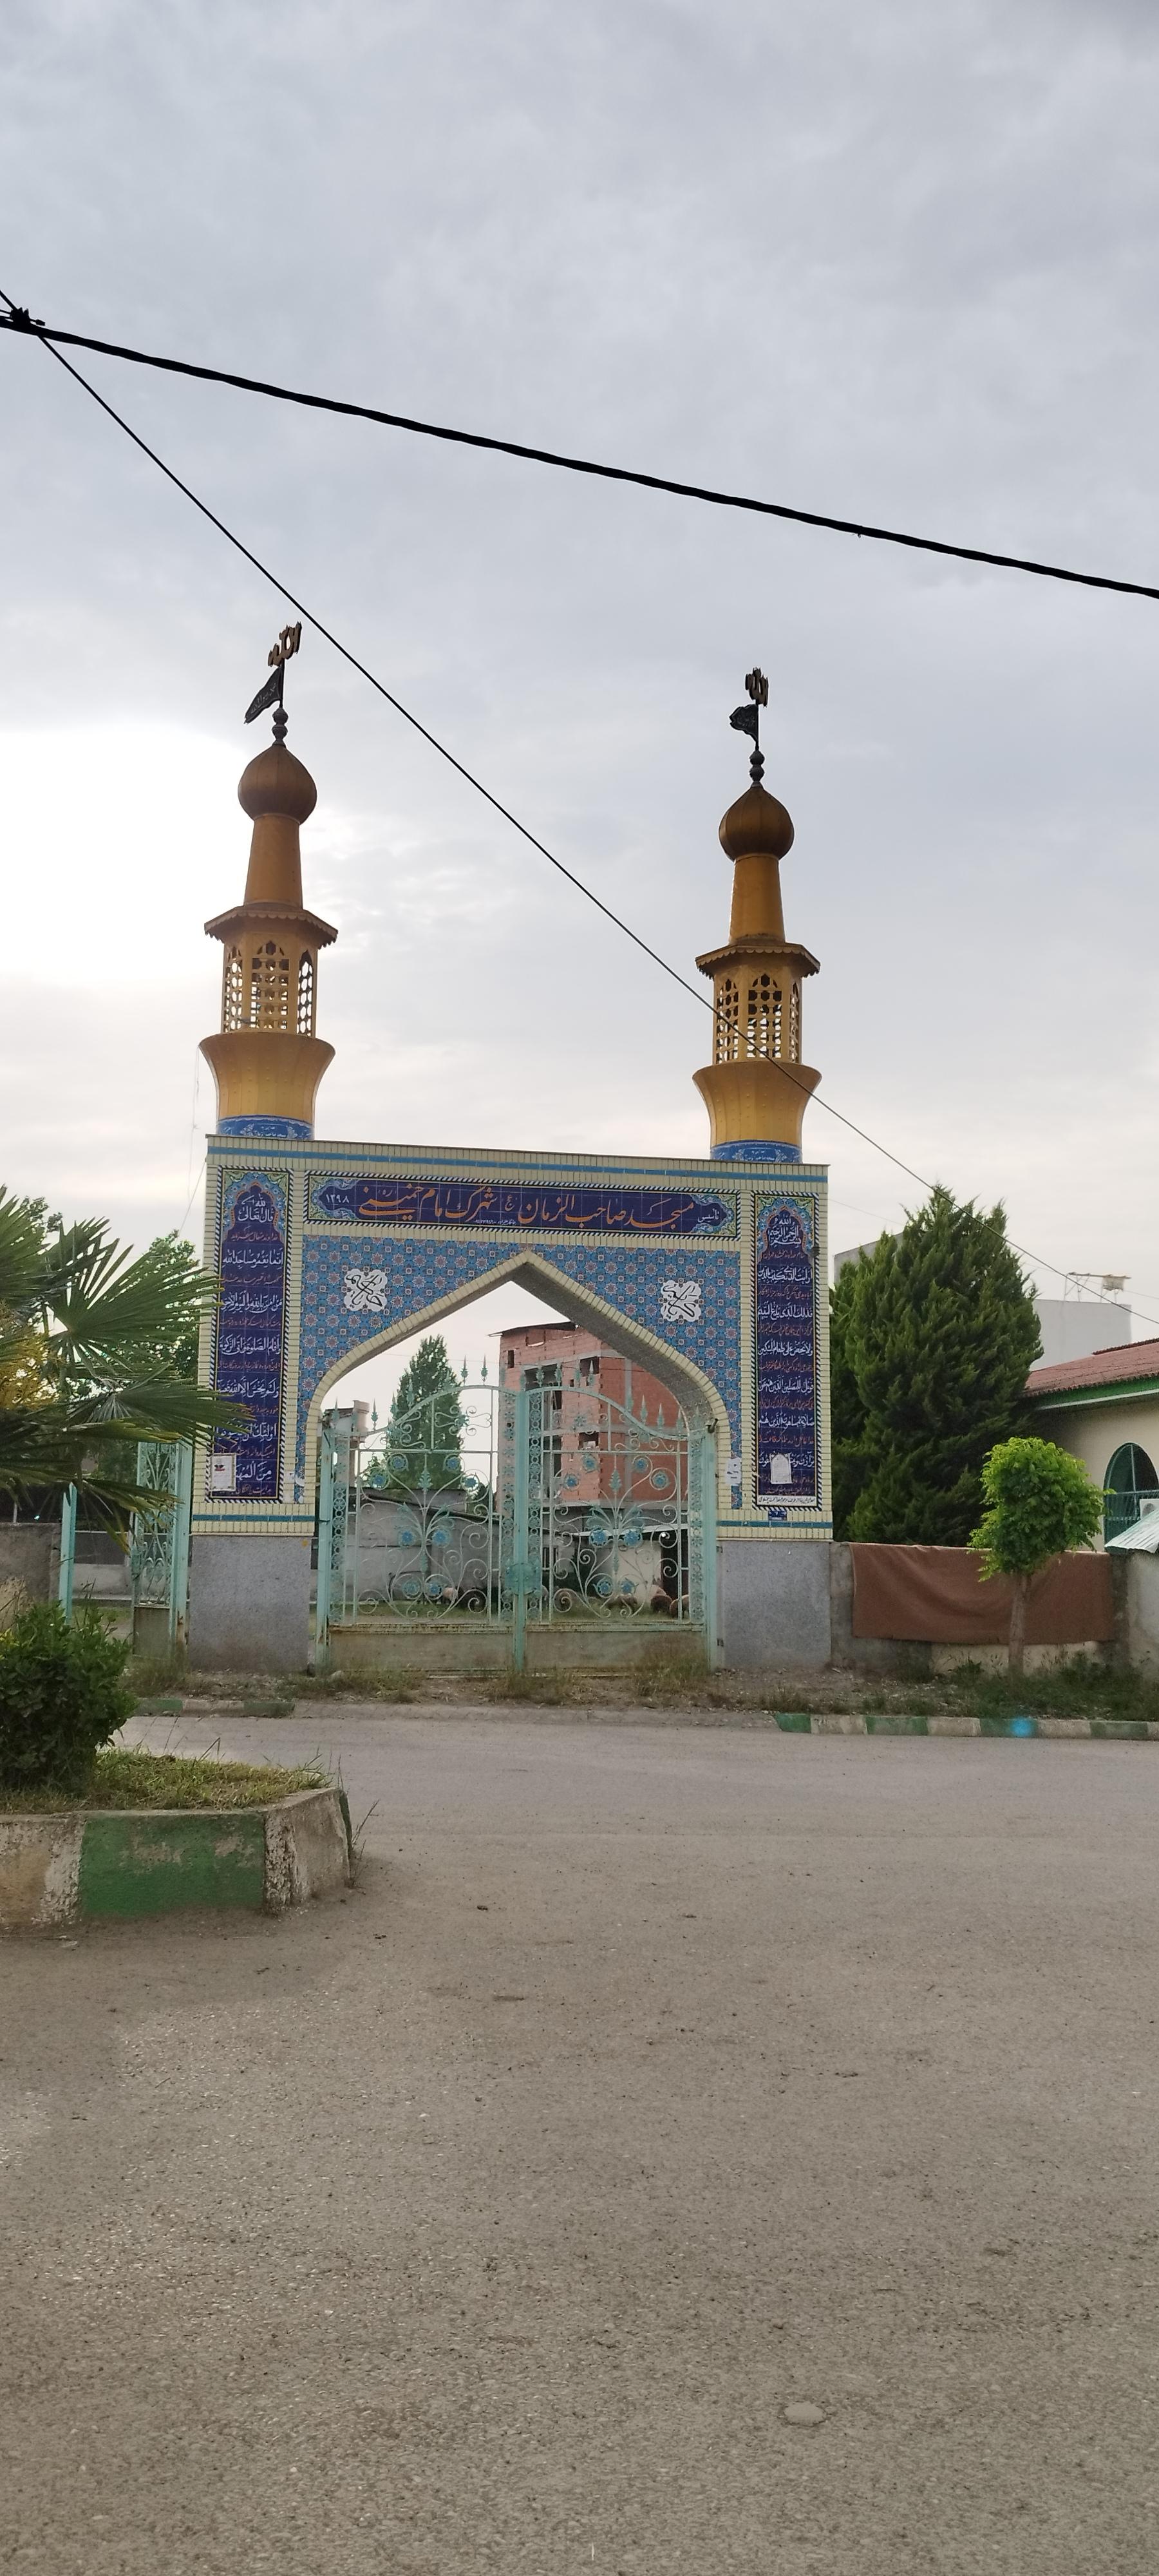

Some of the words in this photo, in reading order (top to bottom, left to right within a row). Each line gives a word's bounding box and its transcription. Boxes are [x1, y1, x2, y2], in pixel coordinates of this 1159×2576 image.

[326, 1193, 350, 1204] ۱۳۹۸
[359, 1184, 424, 1221] خمینی
[419, 1188, 451, 1221] امام
[445, 1186, 497, 1222] شهرک
[518, 1194, 575, 1224] الزمان
[565, 1198, 626, 1229] صاحب
[624, 1198, 693, 1229] مسجد
